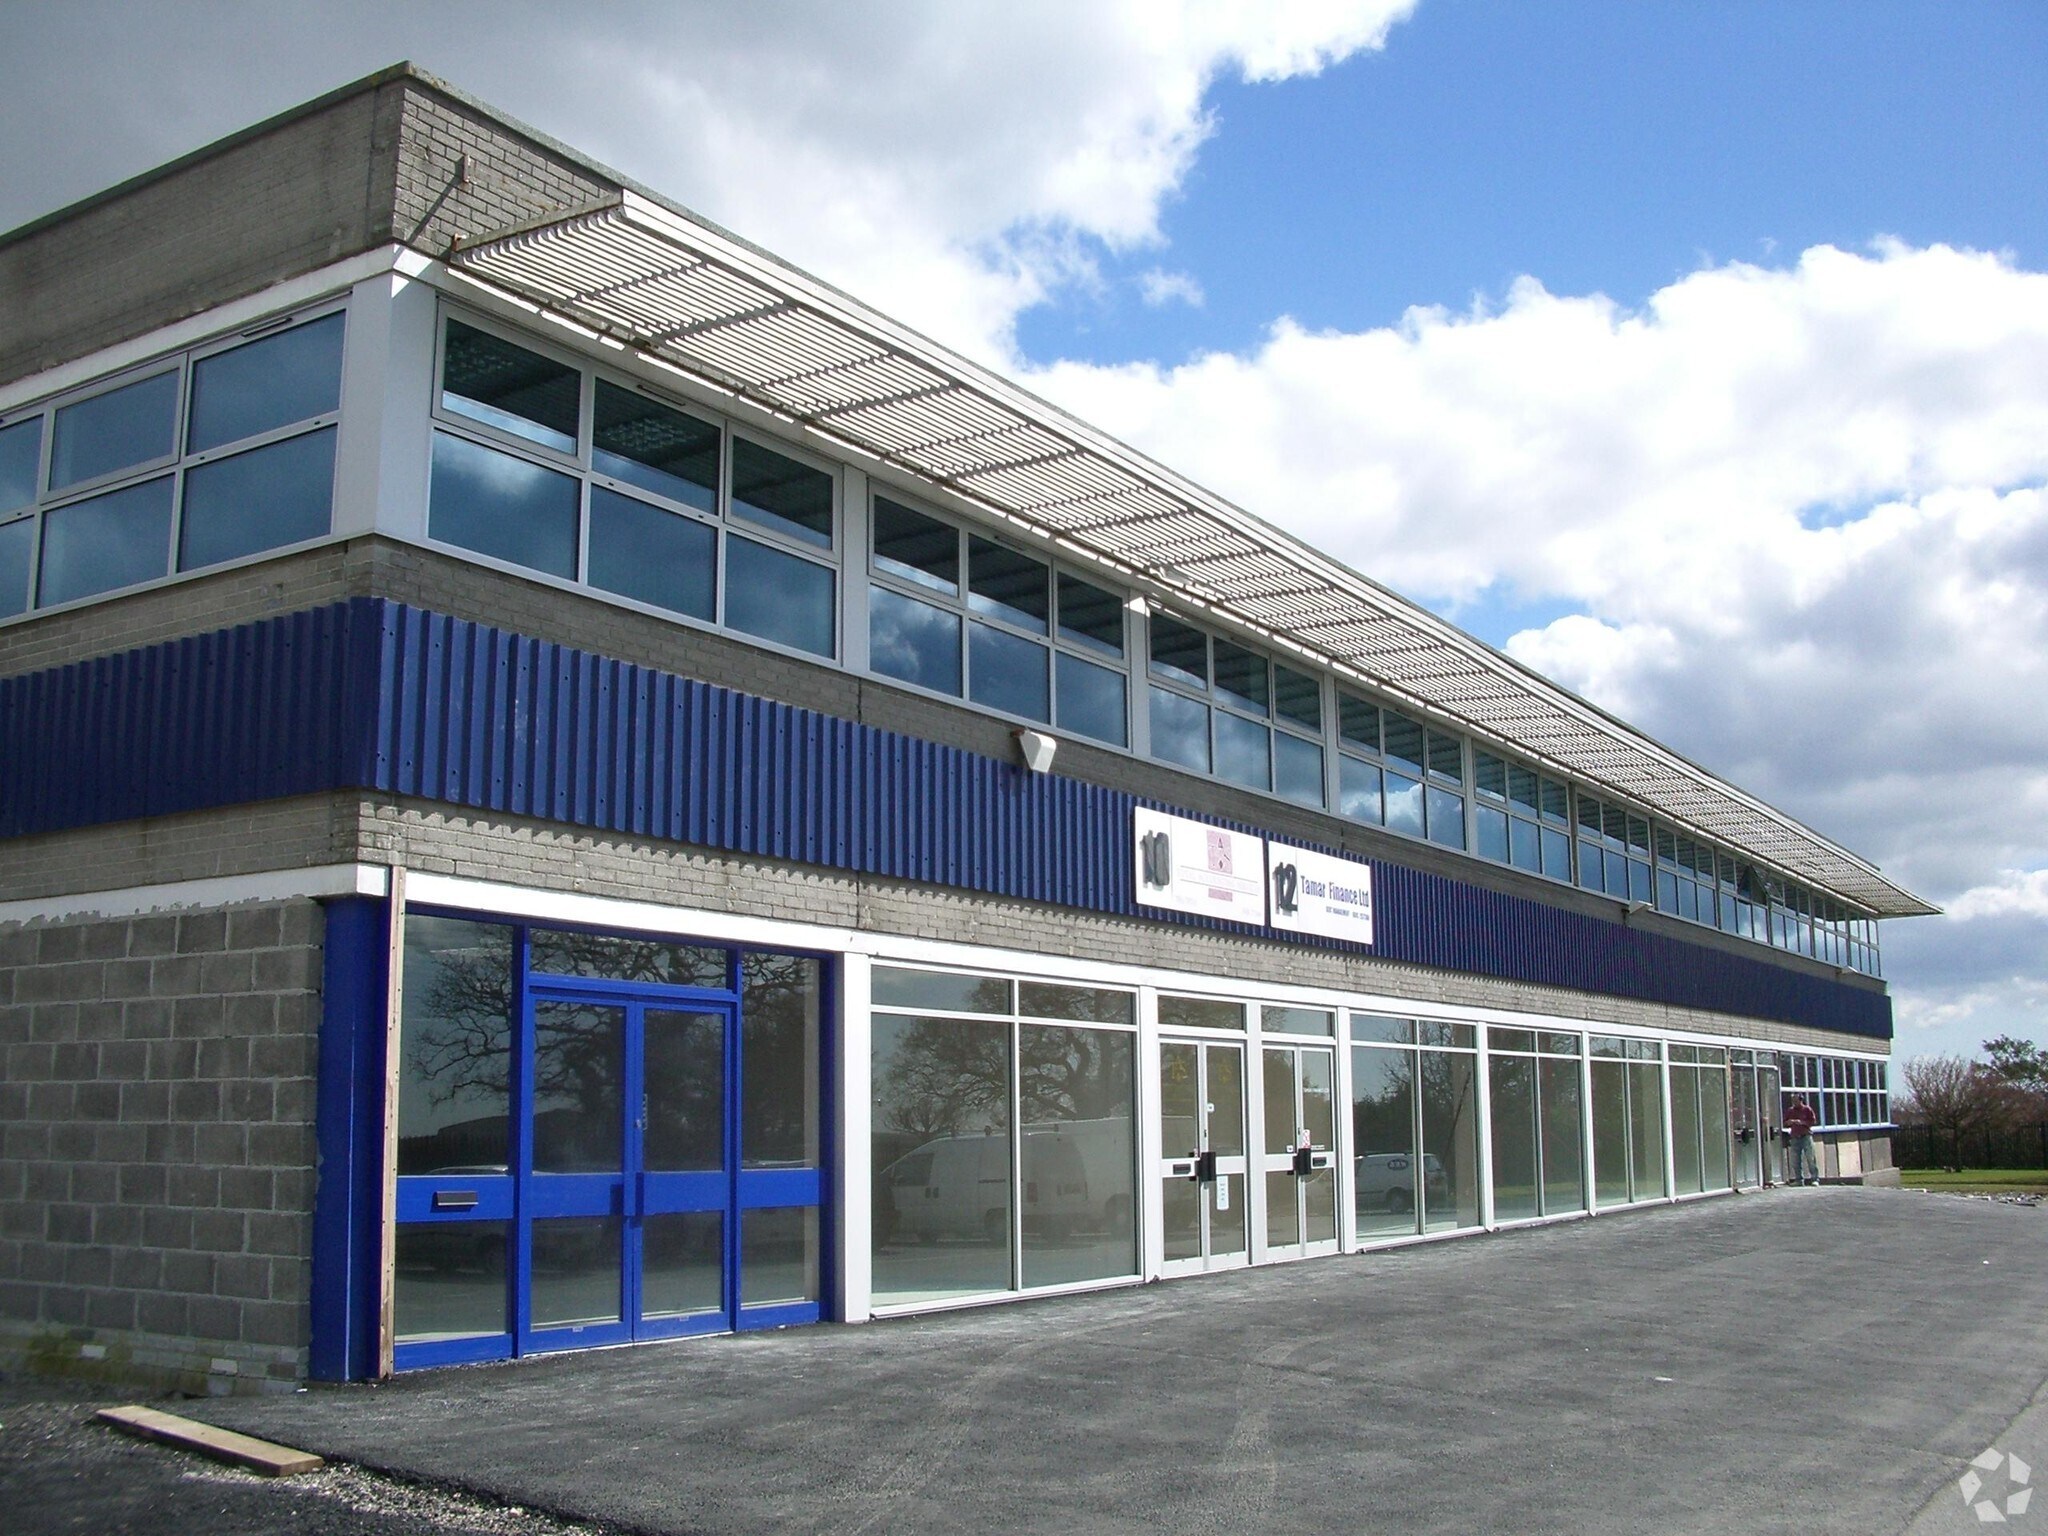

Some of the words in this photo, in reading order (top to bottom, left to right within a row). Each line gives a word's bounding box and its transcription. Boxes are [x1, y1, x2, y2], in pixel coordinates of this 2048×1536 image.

[1140, 830, 1170, 890] 10
[1272, 862, 1297, 916] 12
[1300, 875, 1326, 898] Tamar
[1329, 881, 1358, 905] Finance
[1359, 888, 1370, 908] Ltd
